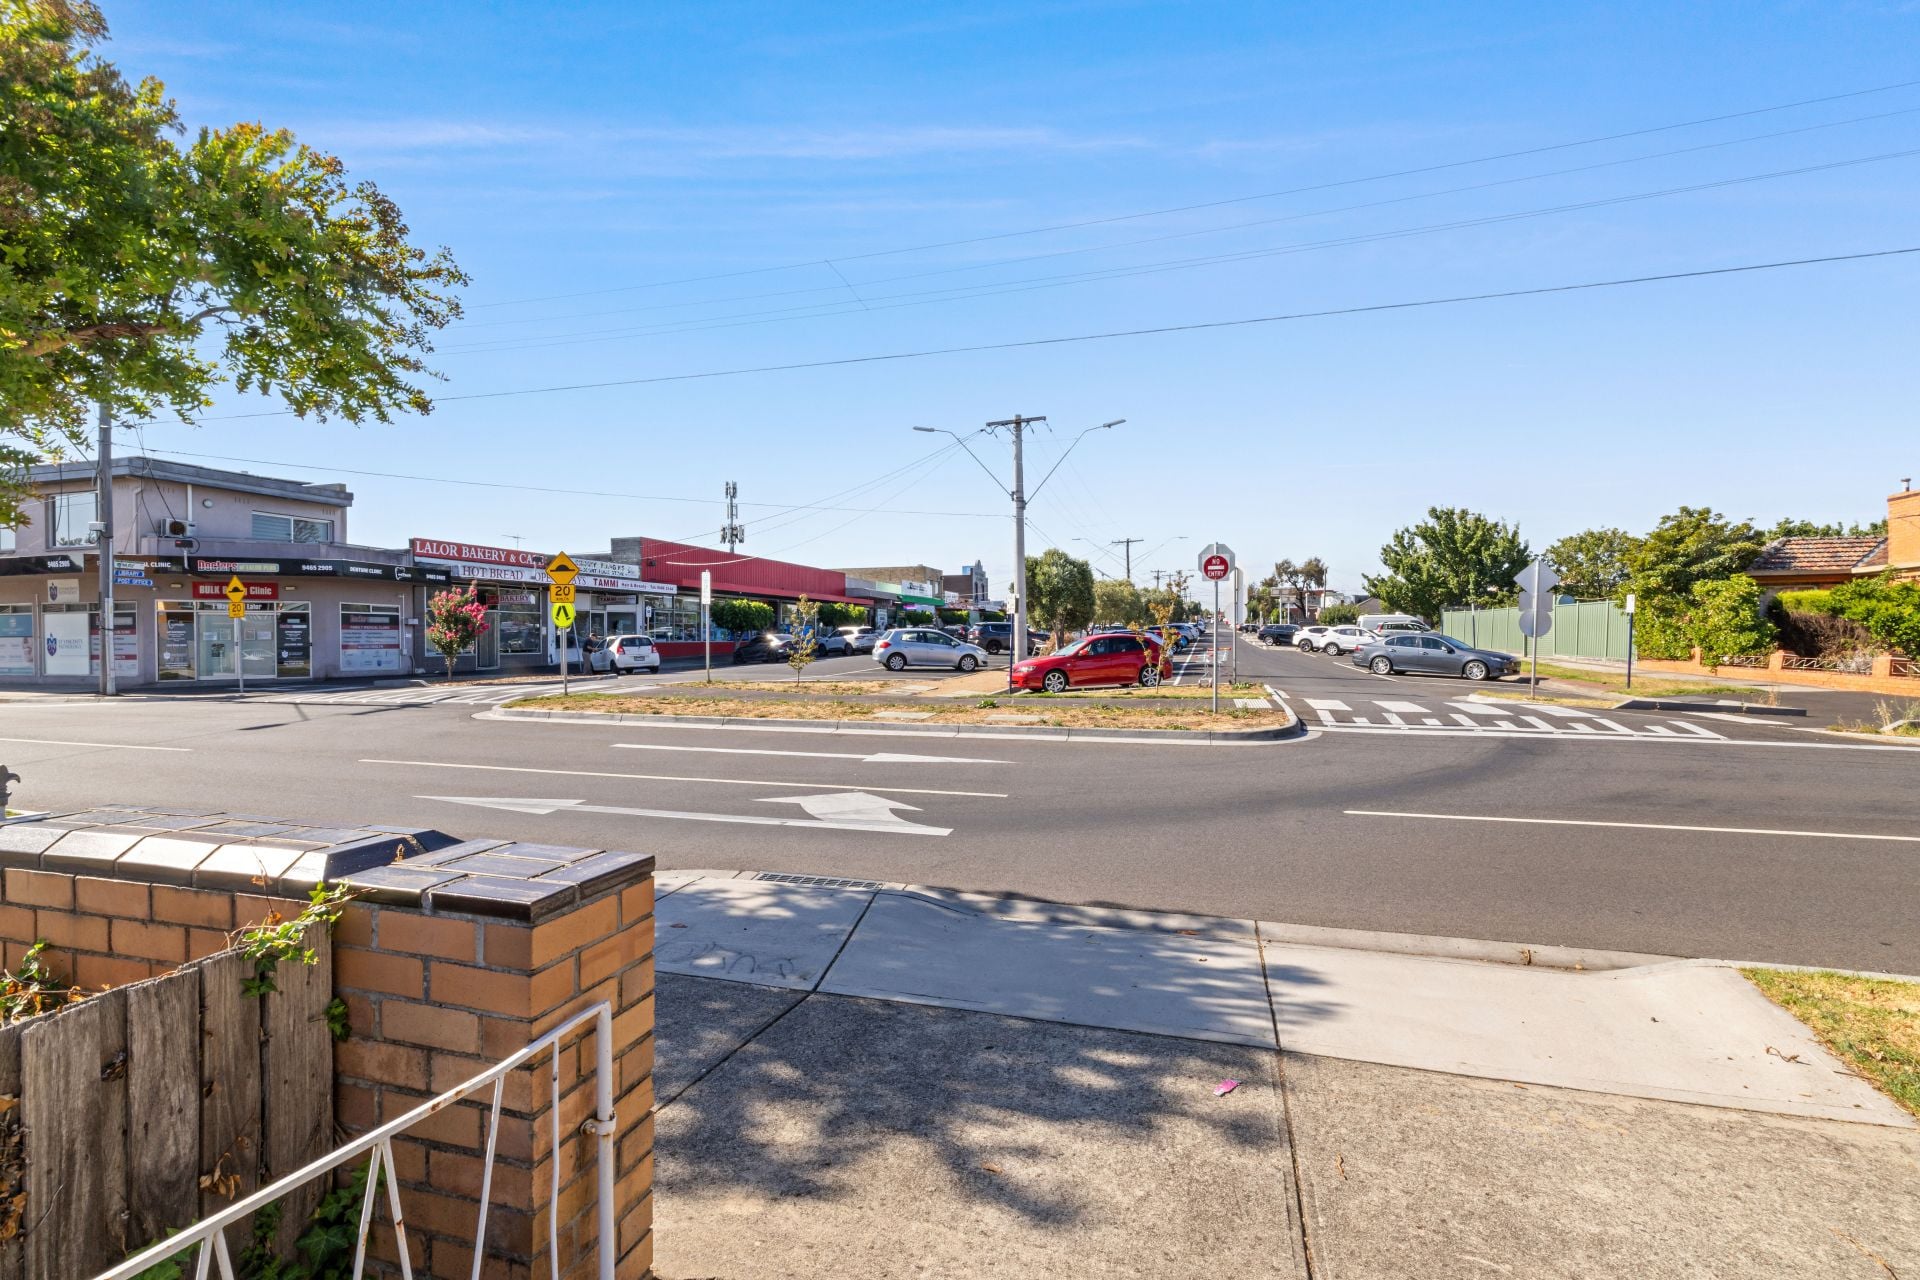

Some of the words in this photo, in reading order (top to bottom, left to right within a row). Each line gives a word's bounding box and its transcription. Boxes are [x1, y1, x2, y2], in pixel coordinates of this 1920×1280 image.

[416, 541, 458, 557] LALOR
[462, 546, 507, 562] BAKERY
[510, 554, 516, 563] &
[462, 565, 487, 578] HOT
[489, 568, 524, 580] BREAD
[535, 572, 552, 583] OPE
[593, 578, 619, 588] TAMMI
[200, 585, 220, 594] BULK
[249, 587, 272, 595] Clinic
[555, 586, 570, 596] 20
[232, 604, 241, 612] 20
